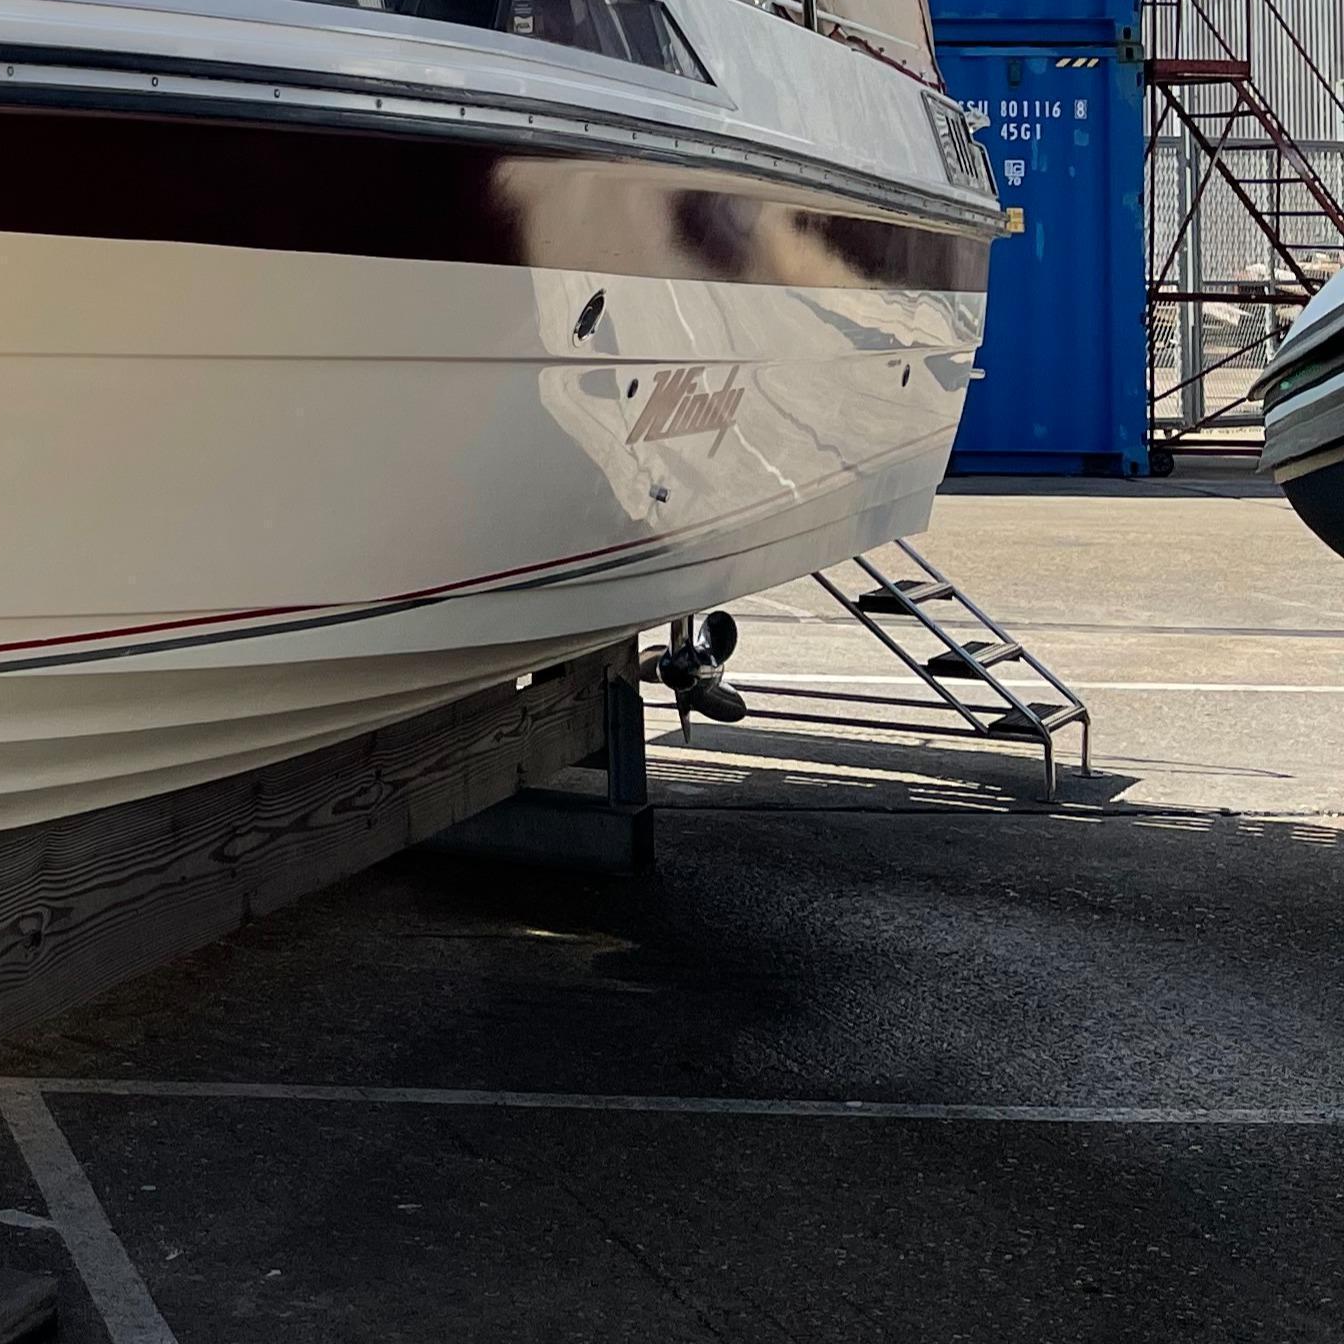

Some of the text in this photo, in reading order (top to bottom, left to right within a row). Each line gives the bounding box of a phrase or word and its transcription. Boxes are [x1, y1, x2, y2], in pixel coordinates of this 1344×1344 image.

[1000, 99, 1062, 118] 801116
[1074, 99, 1087, 119] 8
[1000, 123, 1042, 141] 45G1
[625, 364, 746, 459] Windy
